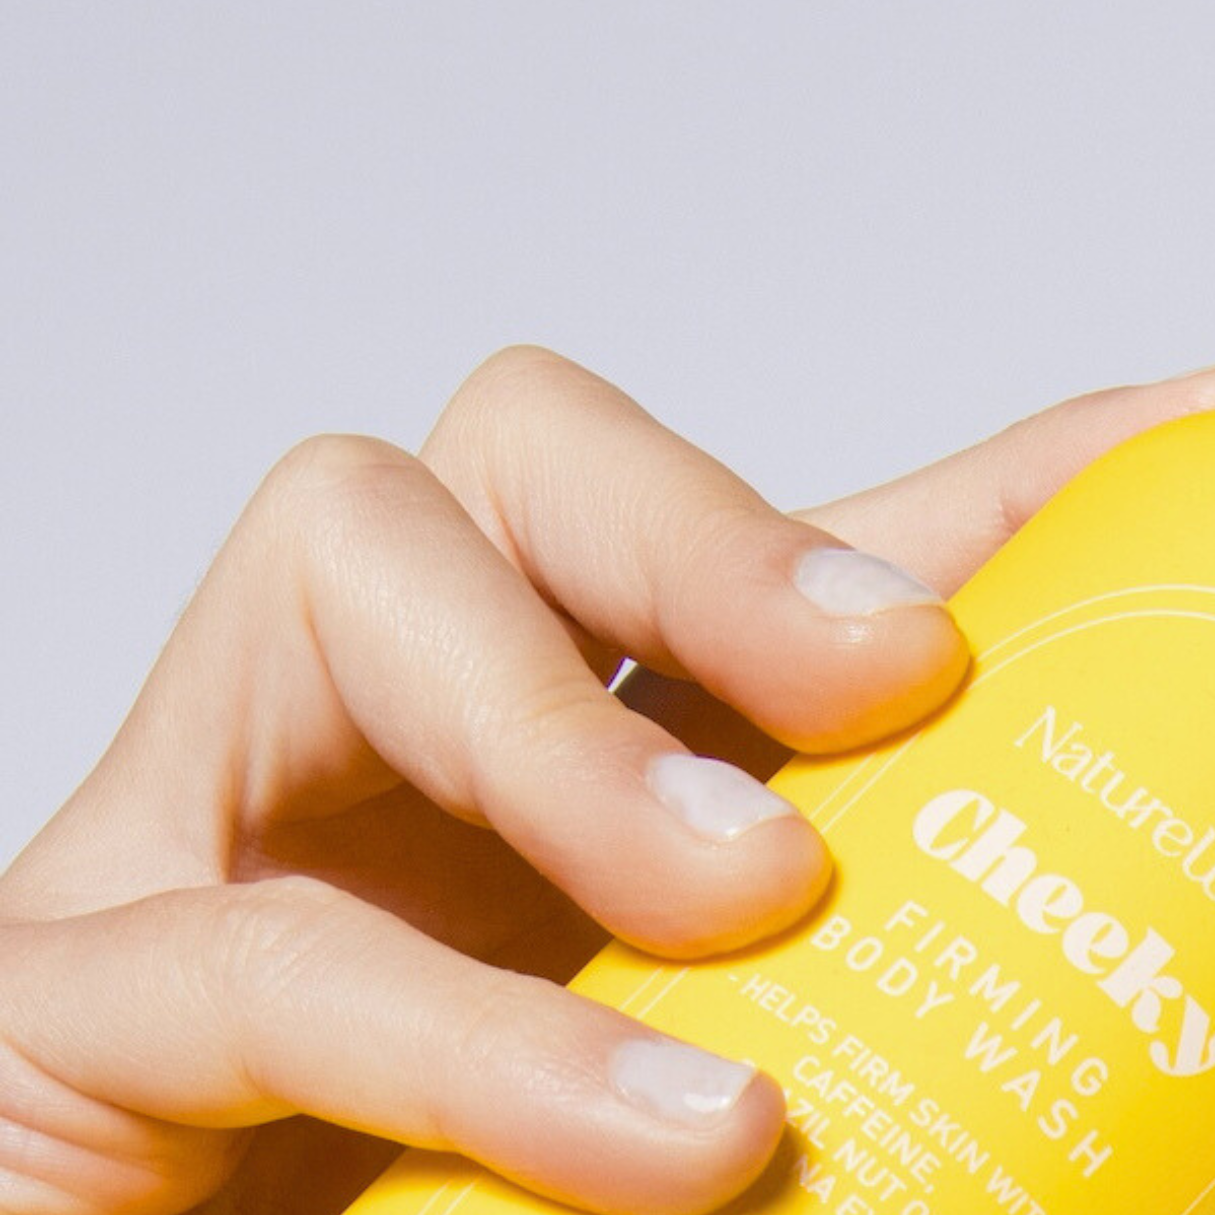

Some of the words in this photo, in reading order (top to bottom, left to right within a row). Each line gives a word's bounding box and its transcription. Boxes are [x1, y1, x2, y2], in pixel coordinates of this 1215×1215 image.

[739, 972, 837, 1045] HELPS
[831, 1033, 916, 1106] FIRM
[909, 1097, 991, 1175] SKIN
[809, 913, 955, 1019] BODY
[963, 1020, 1114, 1180] WASH
[883, 899, 1110, 1097] FIRMING
[791, 1054, 942, 1194] CAFFEINE,
[832, 1138, 908, 1201] NUT
